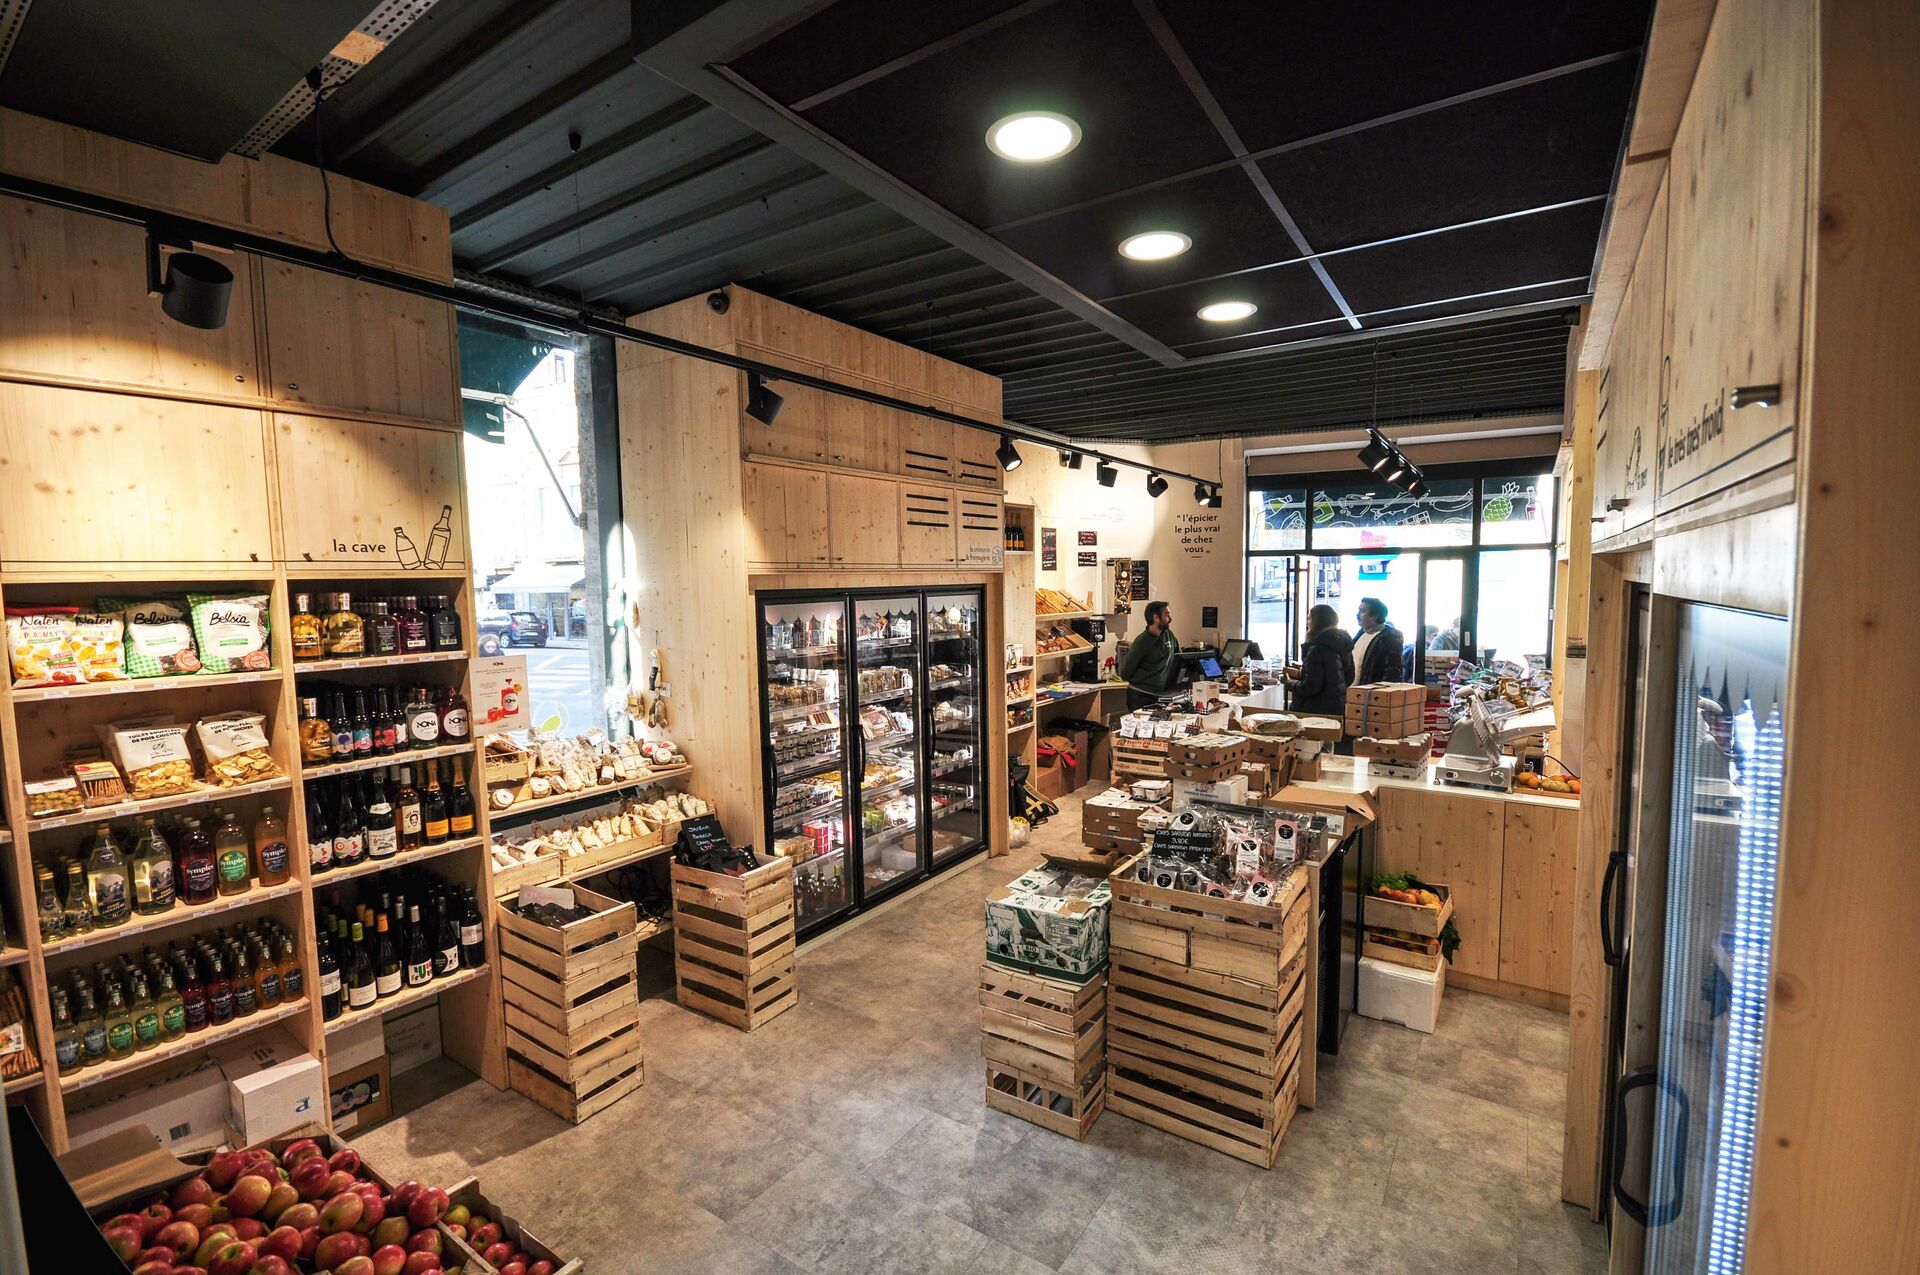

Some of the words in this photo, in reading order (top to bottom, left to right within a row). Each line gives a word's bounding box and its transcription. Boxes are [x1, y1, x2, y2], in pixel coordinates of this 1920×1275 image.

[1701, 387, 1724, 446] froid
[1174, 525, 1182, 534] le
[1184, 525, 1202, 535] plus
[332, 538, 348, 553] la
[351, 543, 387, 553] cave
[1181, 536, 1192, 544] de
[1193, 536, 1213, 544] chez
